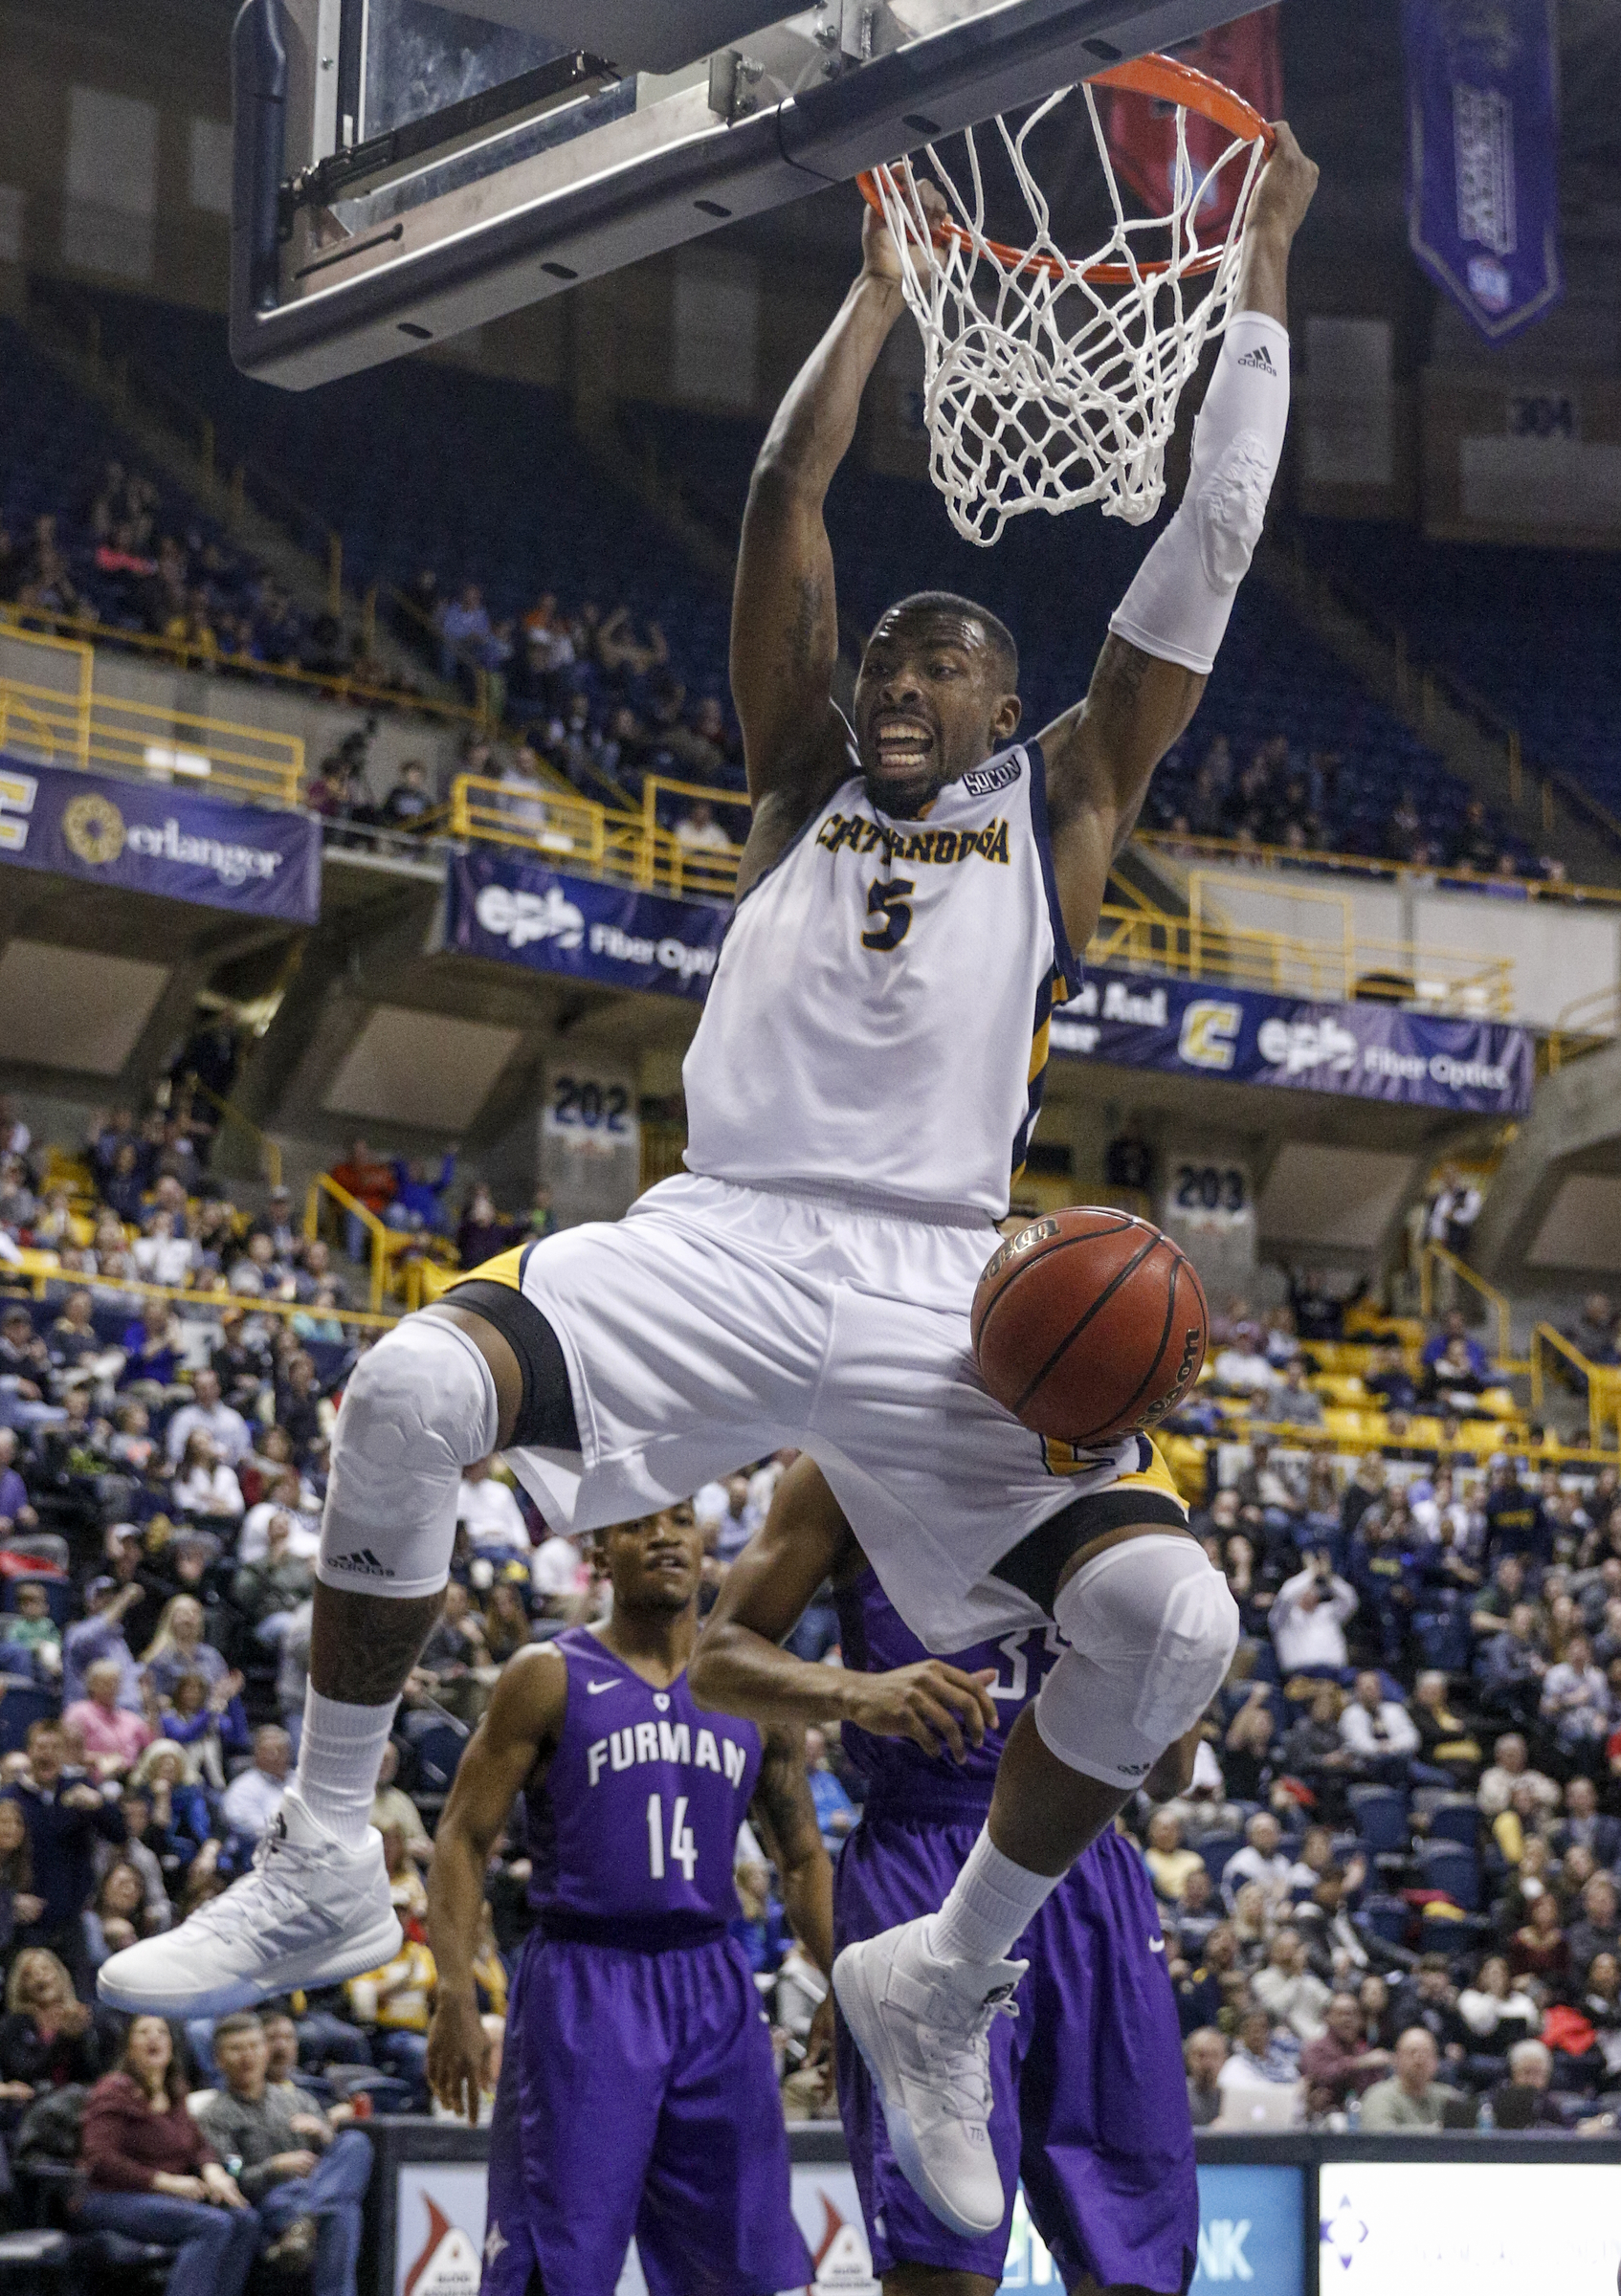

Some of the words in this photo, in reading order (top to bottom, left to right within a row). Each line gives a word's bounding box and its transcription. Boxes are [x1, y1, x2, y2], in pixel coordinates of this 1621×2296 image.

[1237, 357, 1277, 377] adidas
[126, 817, 284, 887] erlanger
[815, 812, 1010, 866] CHATANOOGA
[861, 877, 916, 952] 5
[589, 922, 655, 965] Fiber
[1364, 1046, 1428, 1081] Fiber
[1428, 1054, 1509, 1091] Optics
[556, 1077, 629, 1133] 202
[1177, 1165, 1243, 1212] 203
[587, 1720, 746, 1789] FURMAN
[646, 1793, 699, 1881] 14
